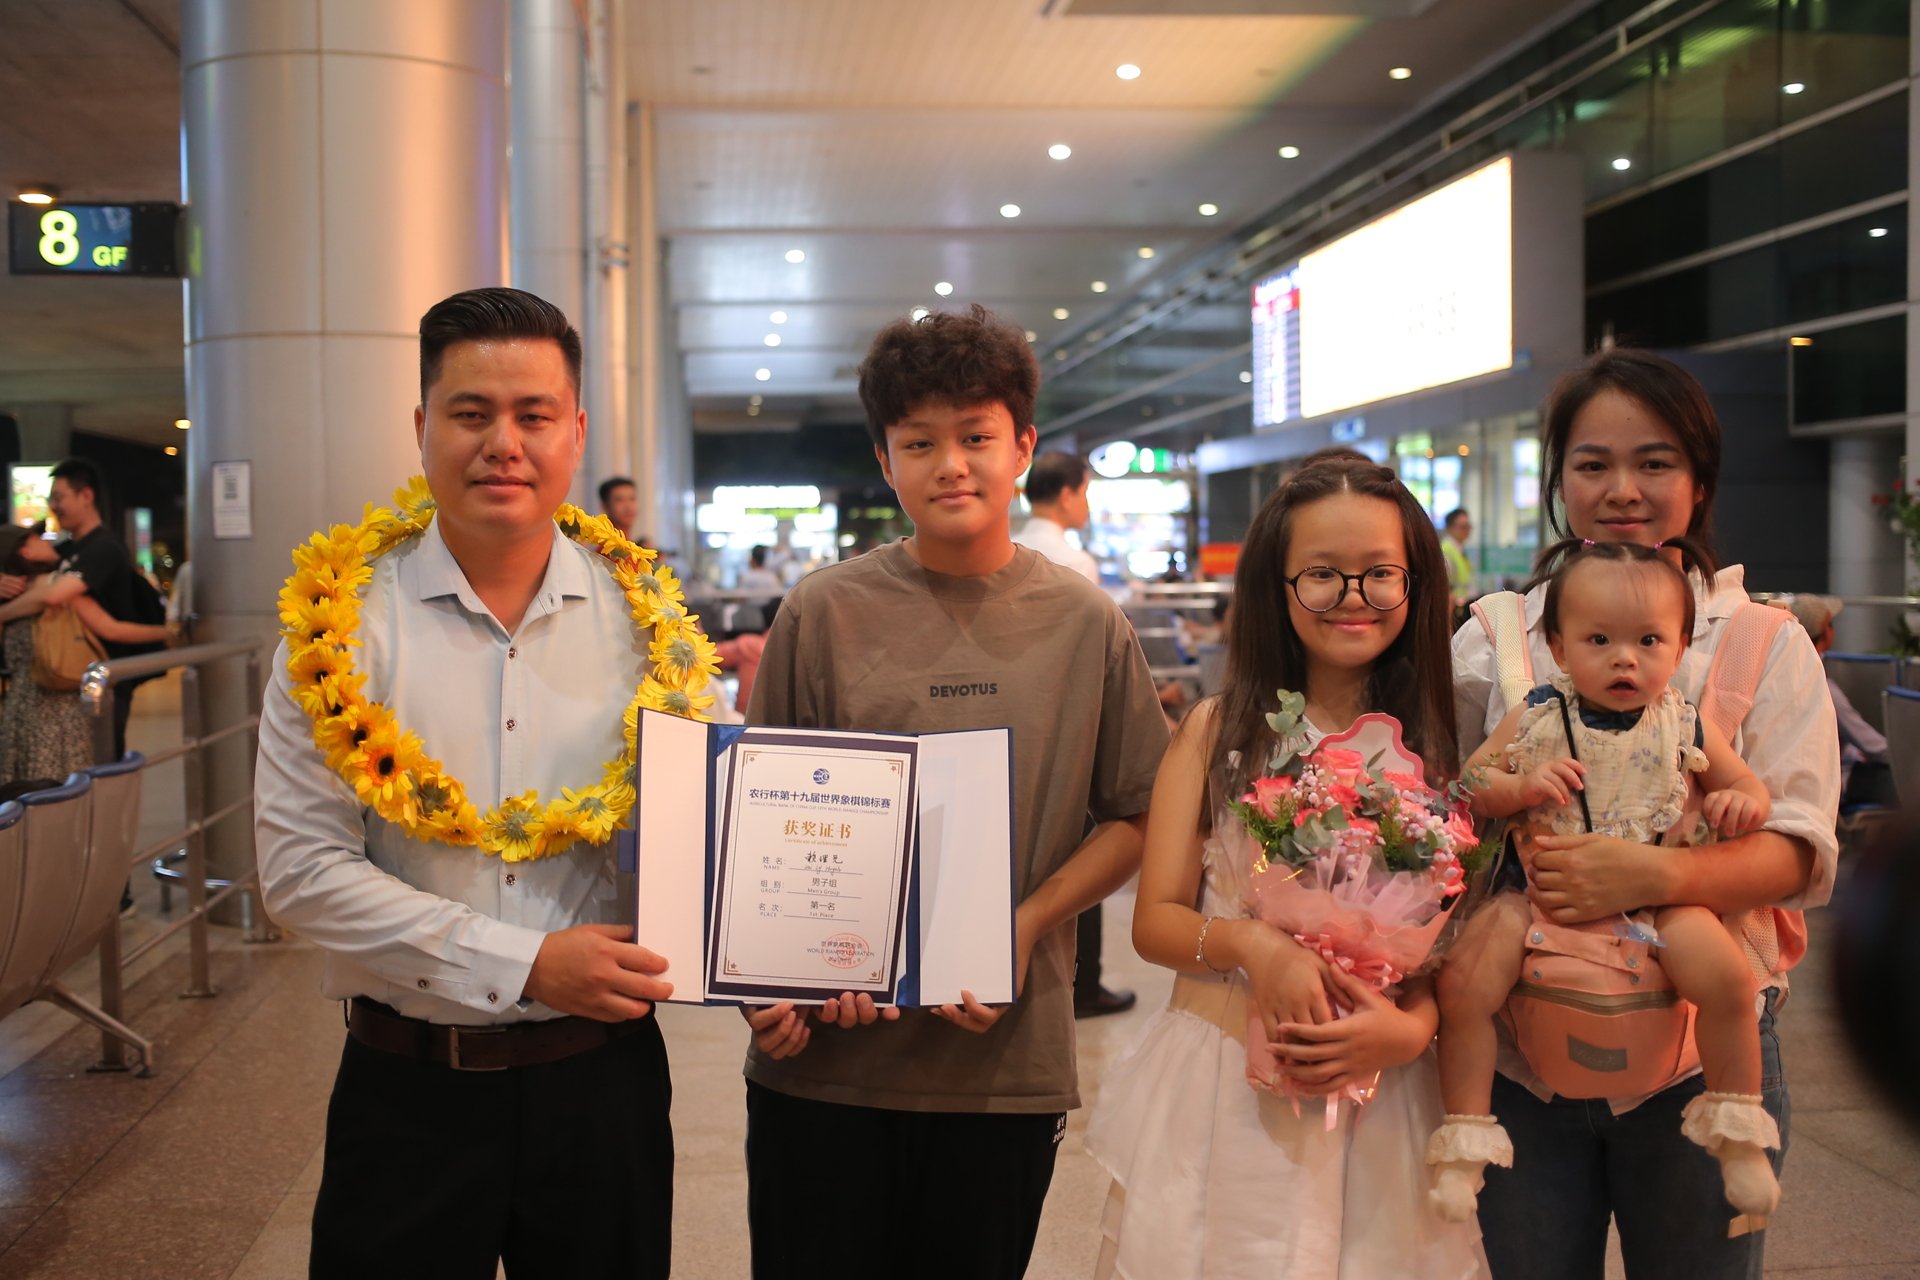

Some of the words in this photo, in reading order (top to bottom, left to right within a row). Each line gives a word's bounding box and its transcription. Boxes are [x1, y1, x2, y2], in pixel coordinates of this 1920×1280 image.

[38, 209, 80, 267] 8
[92, 245, 129, 267] GF
[929, 683, 998, 698] DEVOTUS
[749, 788, 891, 808] 农行杯第十九届世界象棋锦标赛
[784, 819, 852, 838] 获奖证书
[812, 877, 837, 888] 男子组
[810, 900, 836, 911] 第一名
